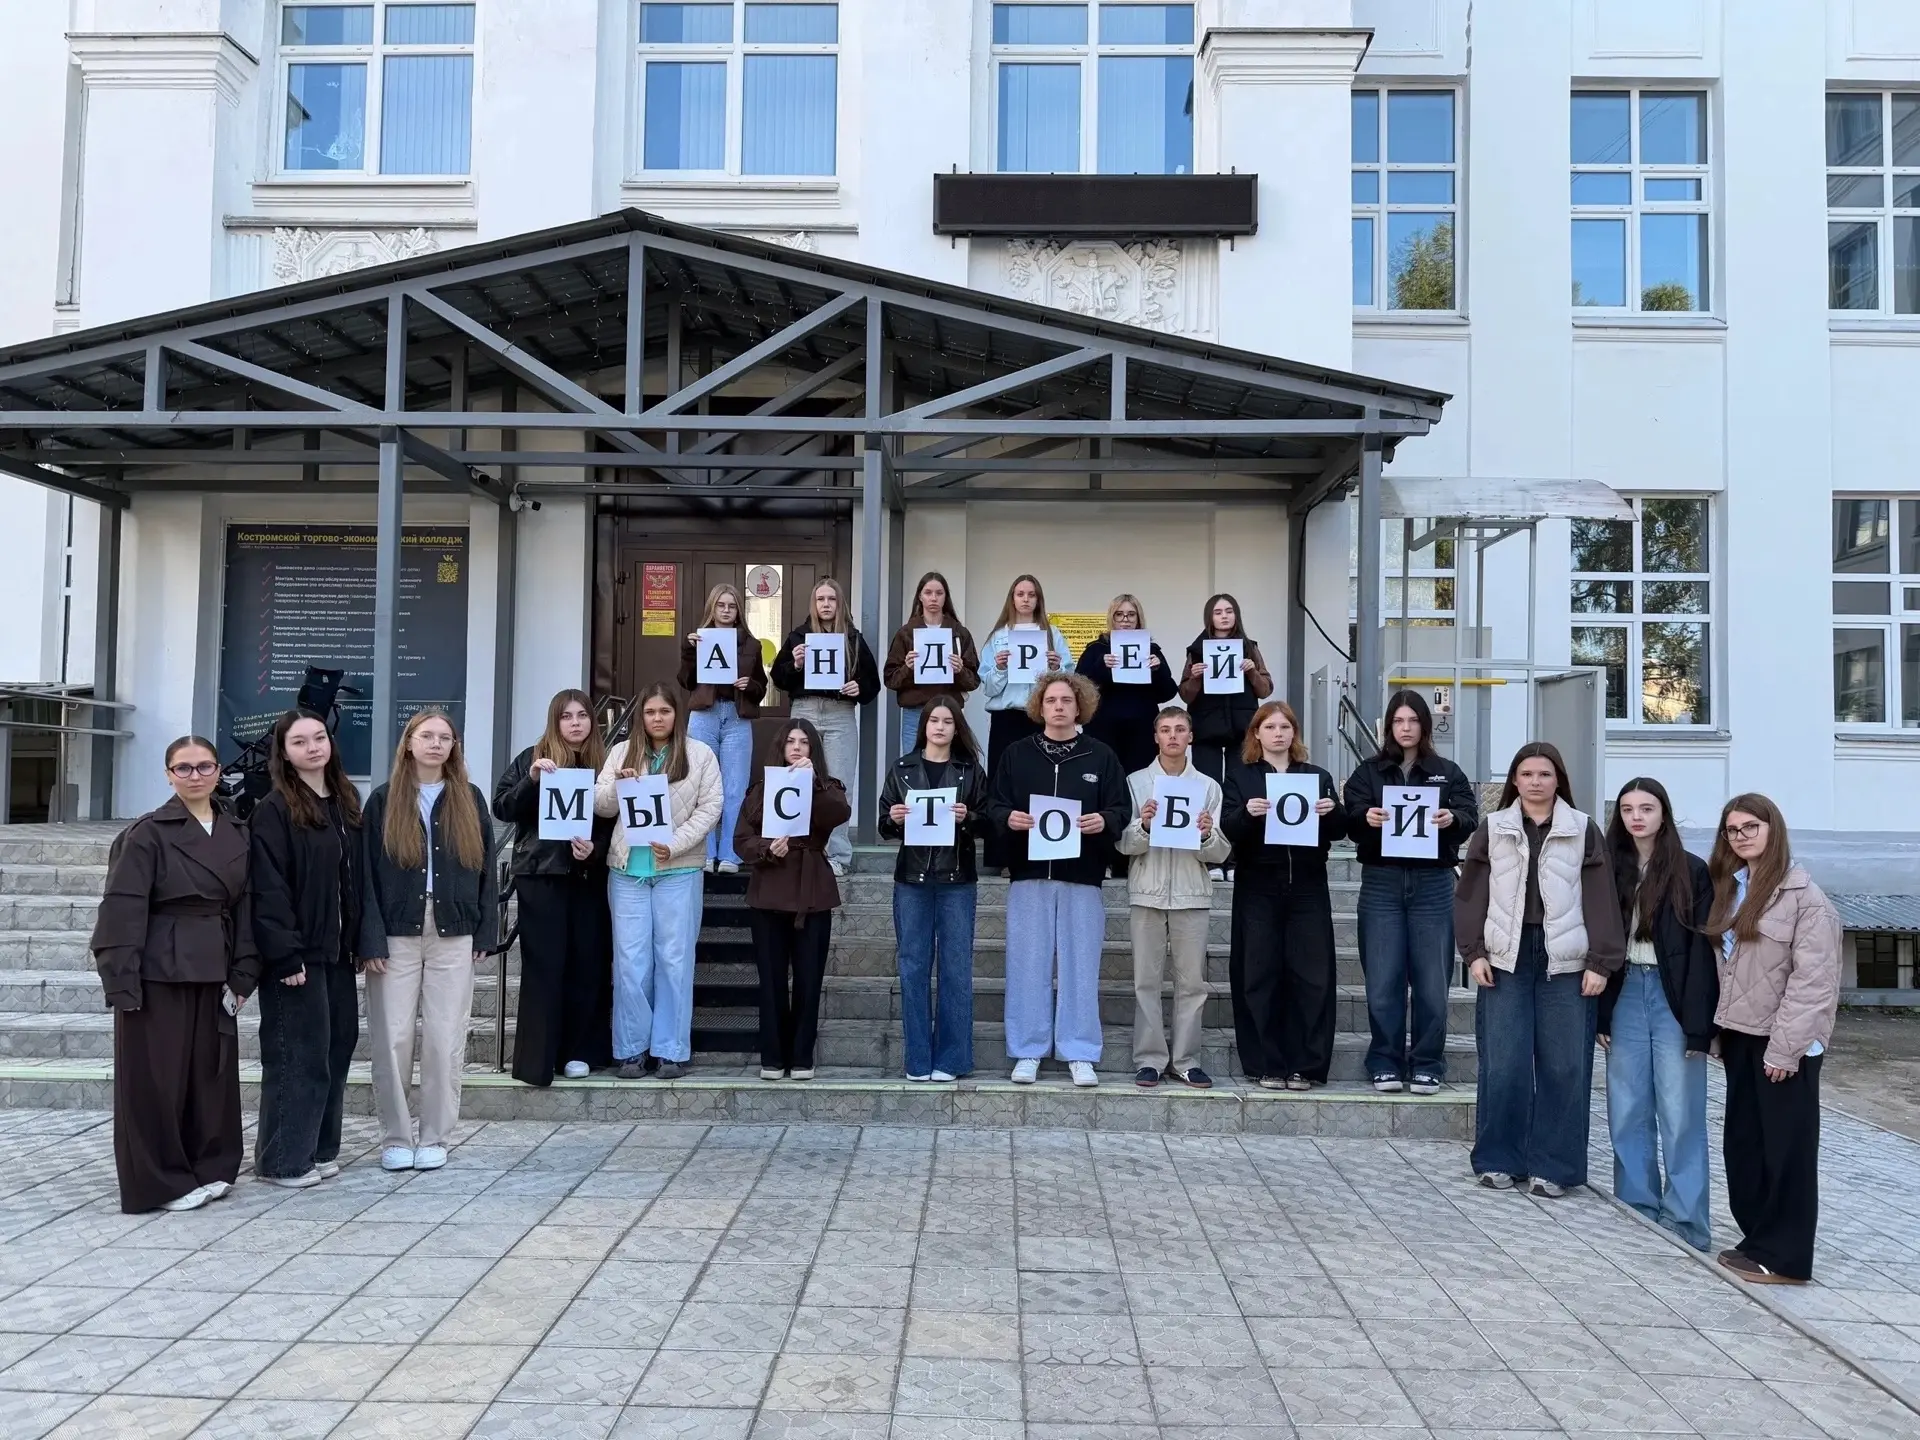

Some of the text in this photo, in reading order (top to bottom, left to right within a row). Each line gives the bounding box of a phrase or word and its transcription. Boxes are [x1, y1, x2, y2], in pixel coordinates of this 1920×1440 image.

[237, 532, 300, 544] Костромской
[419, 535, 463, 545] колледж
[704, 643, 731, 669] А
[811, 648, 839, 675] Н
[920, 643, 947, 675] Д
[1017, 644, 1038, 670] Р
[1119, 644, 1142, 670] Е
[1209, 645, 1238, 679] Й
[544, 787, 589, 821] М
[622, 793, 669, 829] Ы
[773, 786, 801, 821] С
[915, 796, 946, 827] Т
[1162, 795, 1191, 829] Б
[1275, 792, 1310, 826] О
[1390, 793, 1430, 838] Й
[1038, 809, 1071, 842] О
